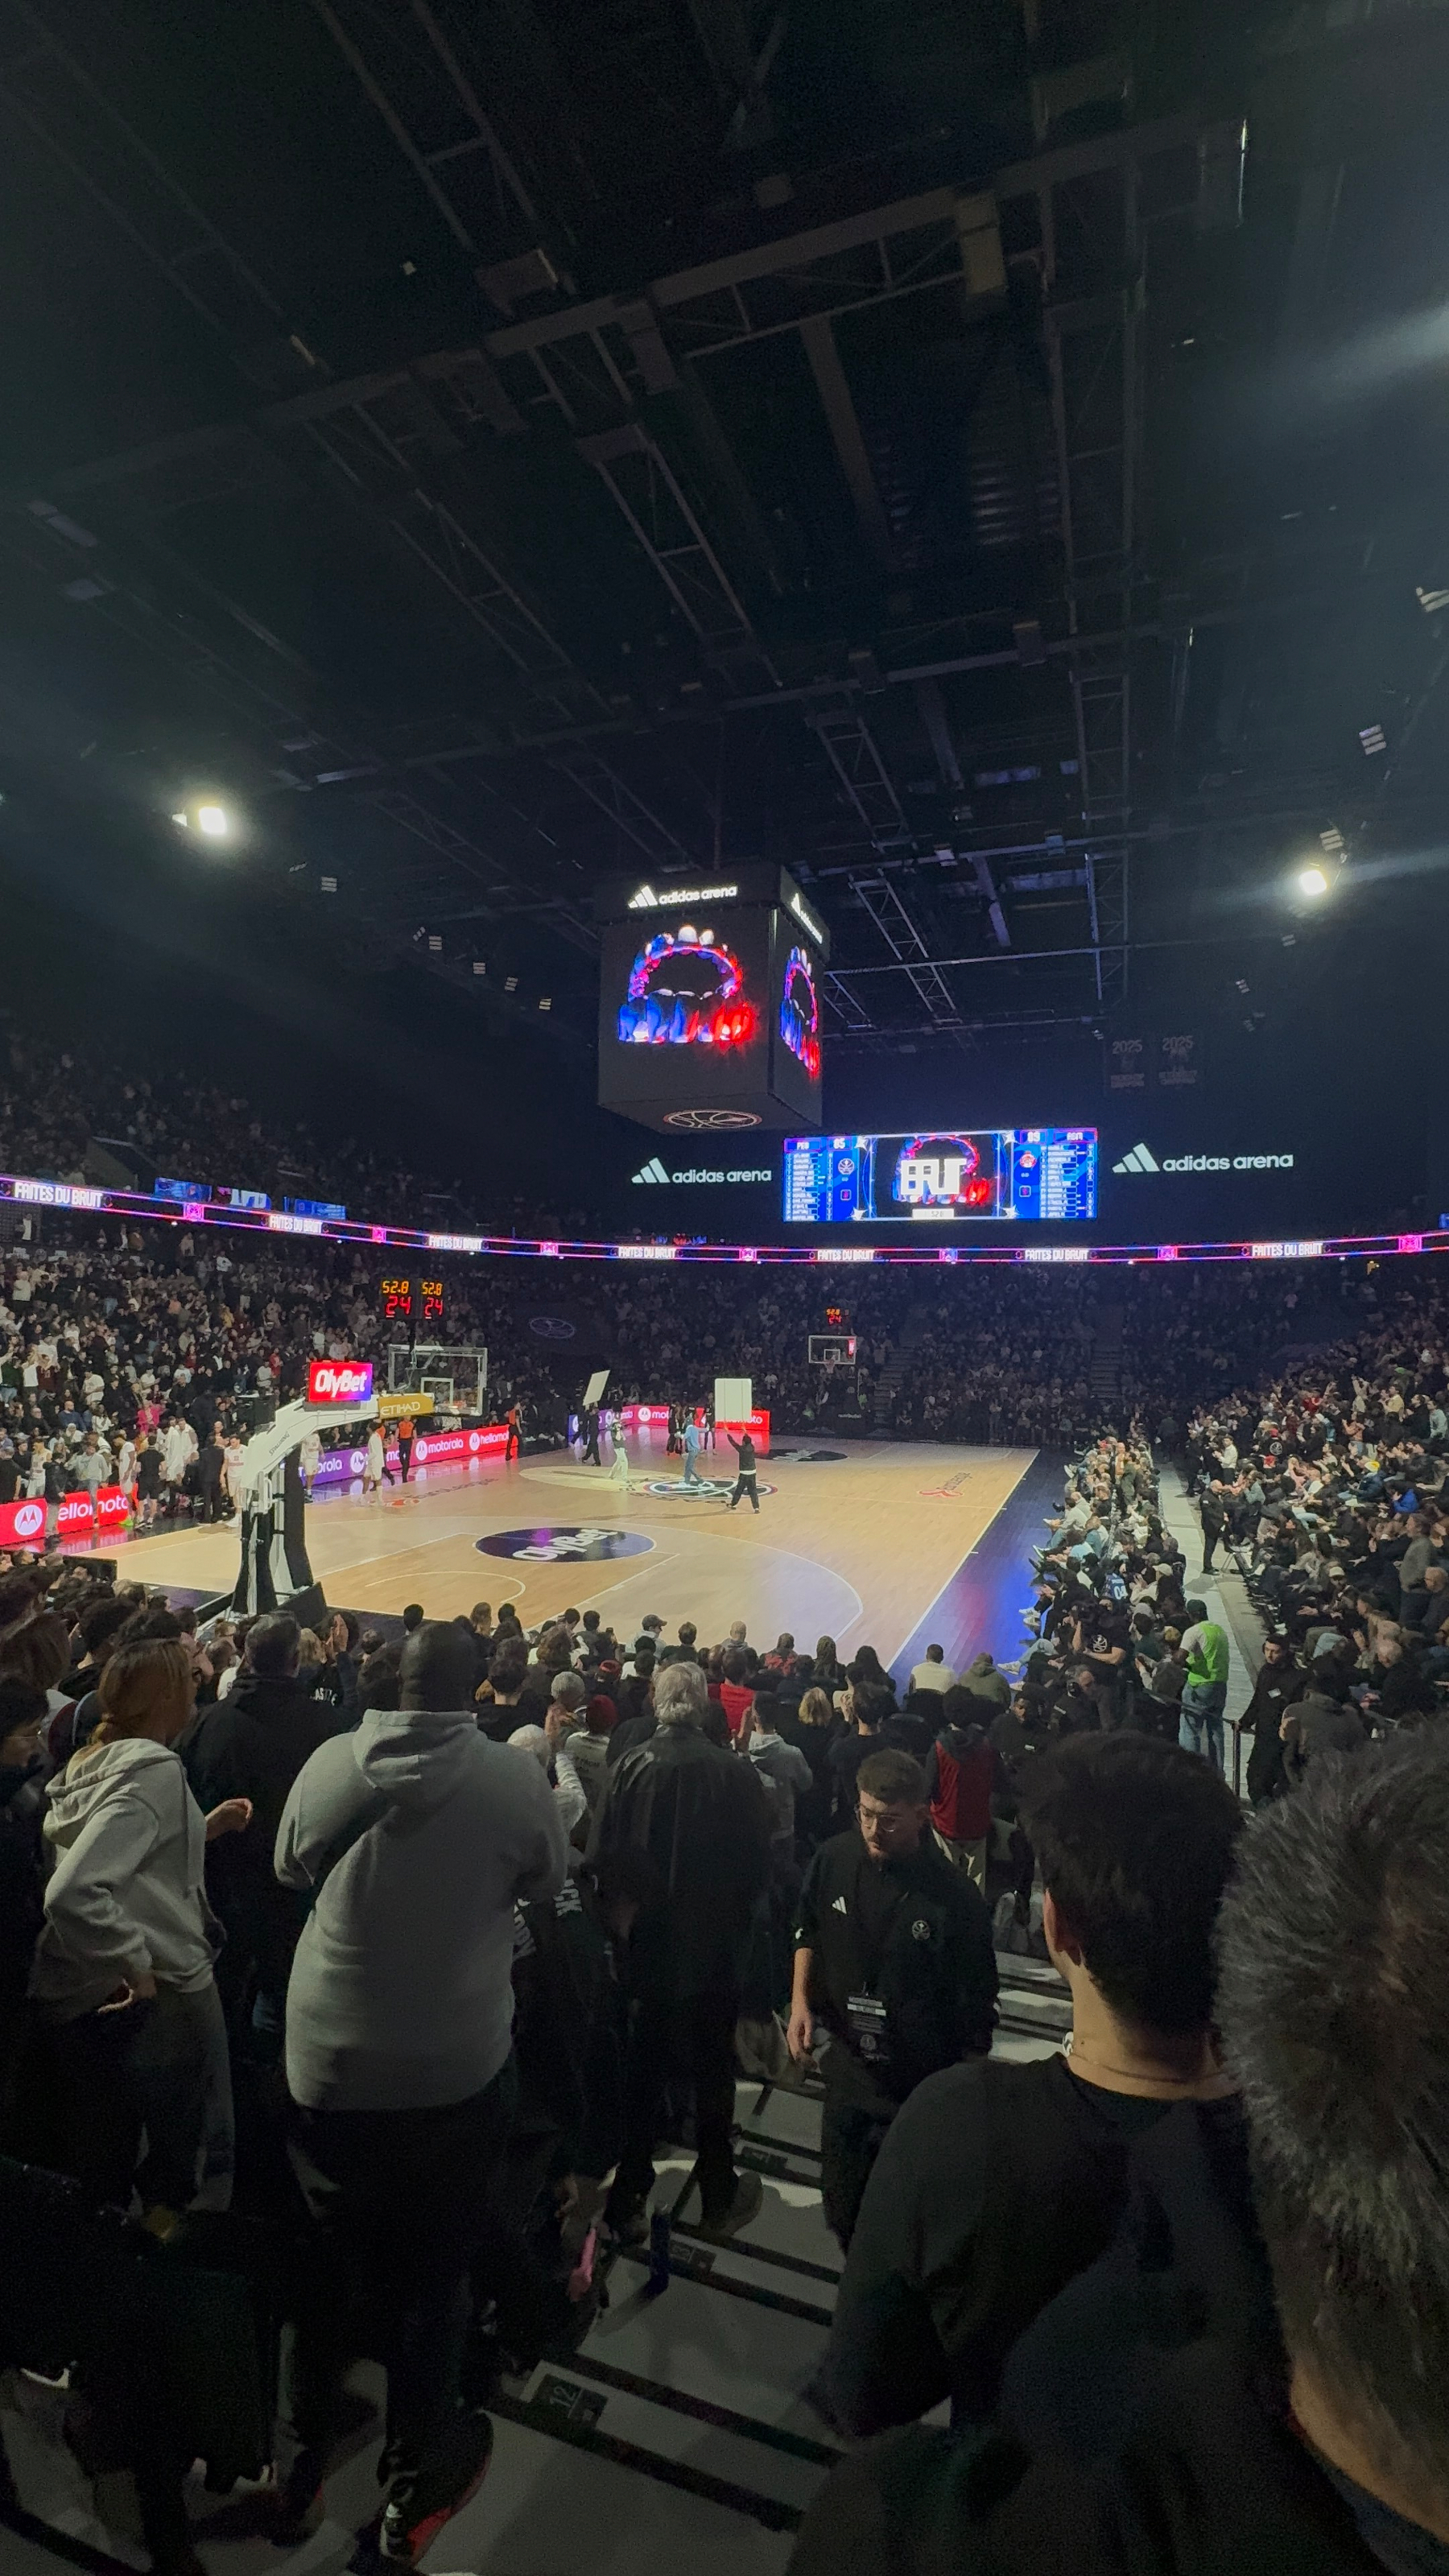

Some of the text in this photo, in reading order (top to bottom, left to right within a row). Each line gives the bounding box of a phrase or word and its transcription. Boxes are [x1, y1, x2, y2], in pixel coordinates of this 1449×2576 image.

[658, 886, 738, 905] adidas arena
[1162, 1154, 1294, 1172] adidas arena
[672, 1170, 772, 1183] adidas arena
[14, 1182, 103, 1208] FAITES DU BRUIT
[1252, 1243, 1323, 1257] FAITES DU BRUIT
[382, 1281, 410, 1294] 52.8
[422, 1282, 444, 1296] 52.8
[386, 1295, 411, 1315] 24
[424, 1297, 444, 1316] 24
[314, 1369, 367, 1398] OlyBet
[380, 1401, 421, 1416] ETIHAD
[427, 1438, 464, 1454] motorola
[512, 1529, 618, 1561] OlyBet
[549, 2385, 576, 2409] 12
